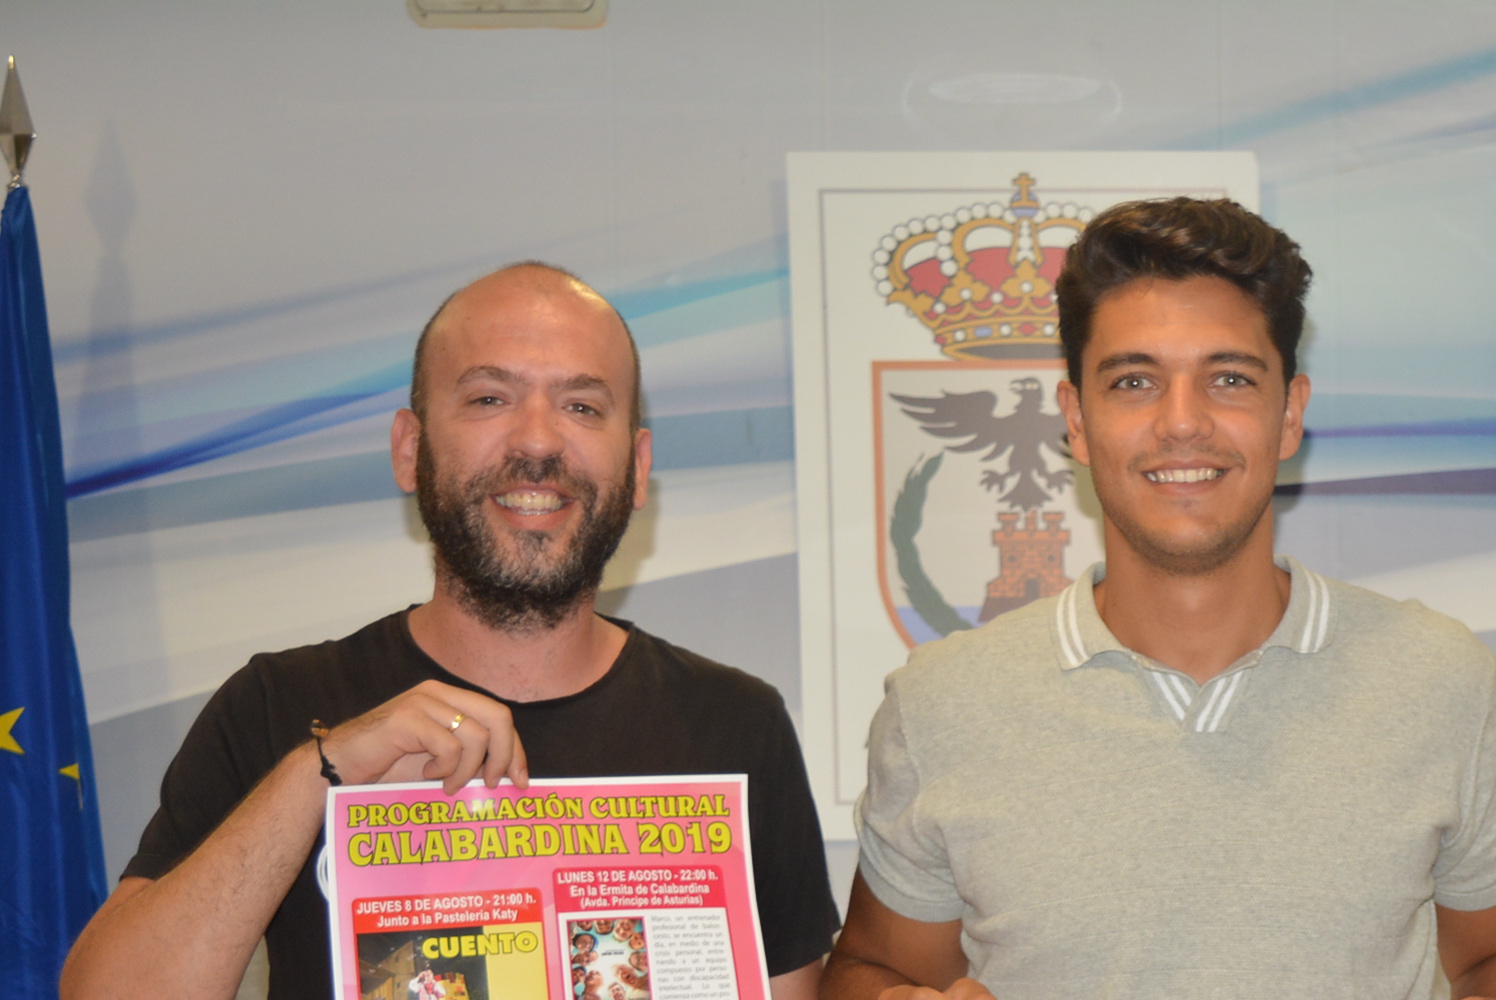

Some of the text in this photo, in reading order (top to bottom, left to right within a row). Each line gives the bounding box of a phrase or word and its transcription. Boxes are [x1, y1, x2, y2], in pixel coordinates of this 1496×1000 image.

[347, 792, 730, 828] PROGRAMACIÓN CULTURAL
[347, 821, 732, 868] CALABARDINA 2019
[356, 900, 402, 914] JUEVES
[404, 899, 412, 911] 8
[414, 898, 431, 910] DE
[434, 895, 483, 909] AGOSTO
[492, 893, 523, 906] 21:00
[524, 892, 536, 904] h.
[377, 907, 518, 927] Junto a la Pastelería Katy
[421, 930, 540, 959] CUENTO
